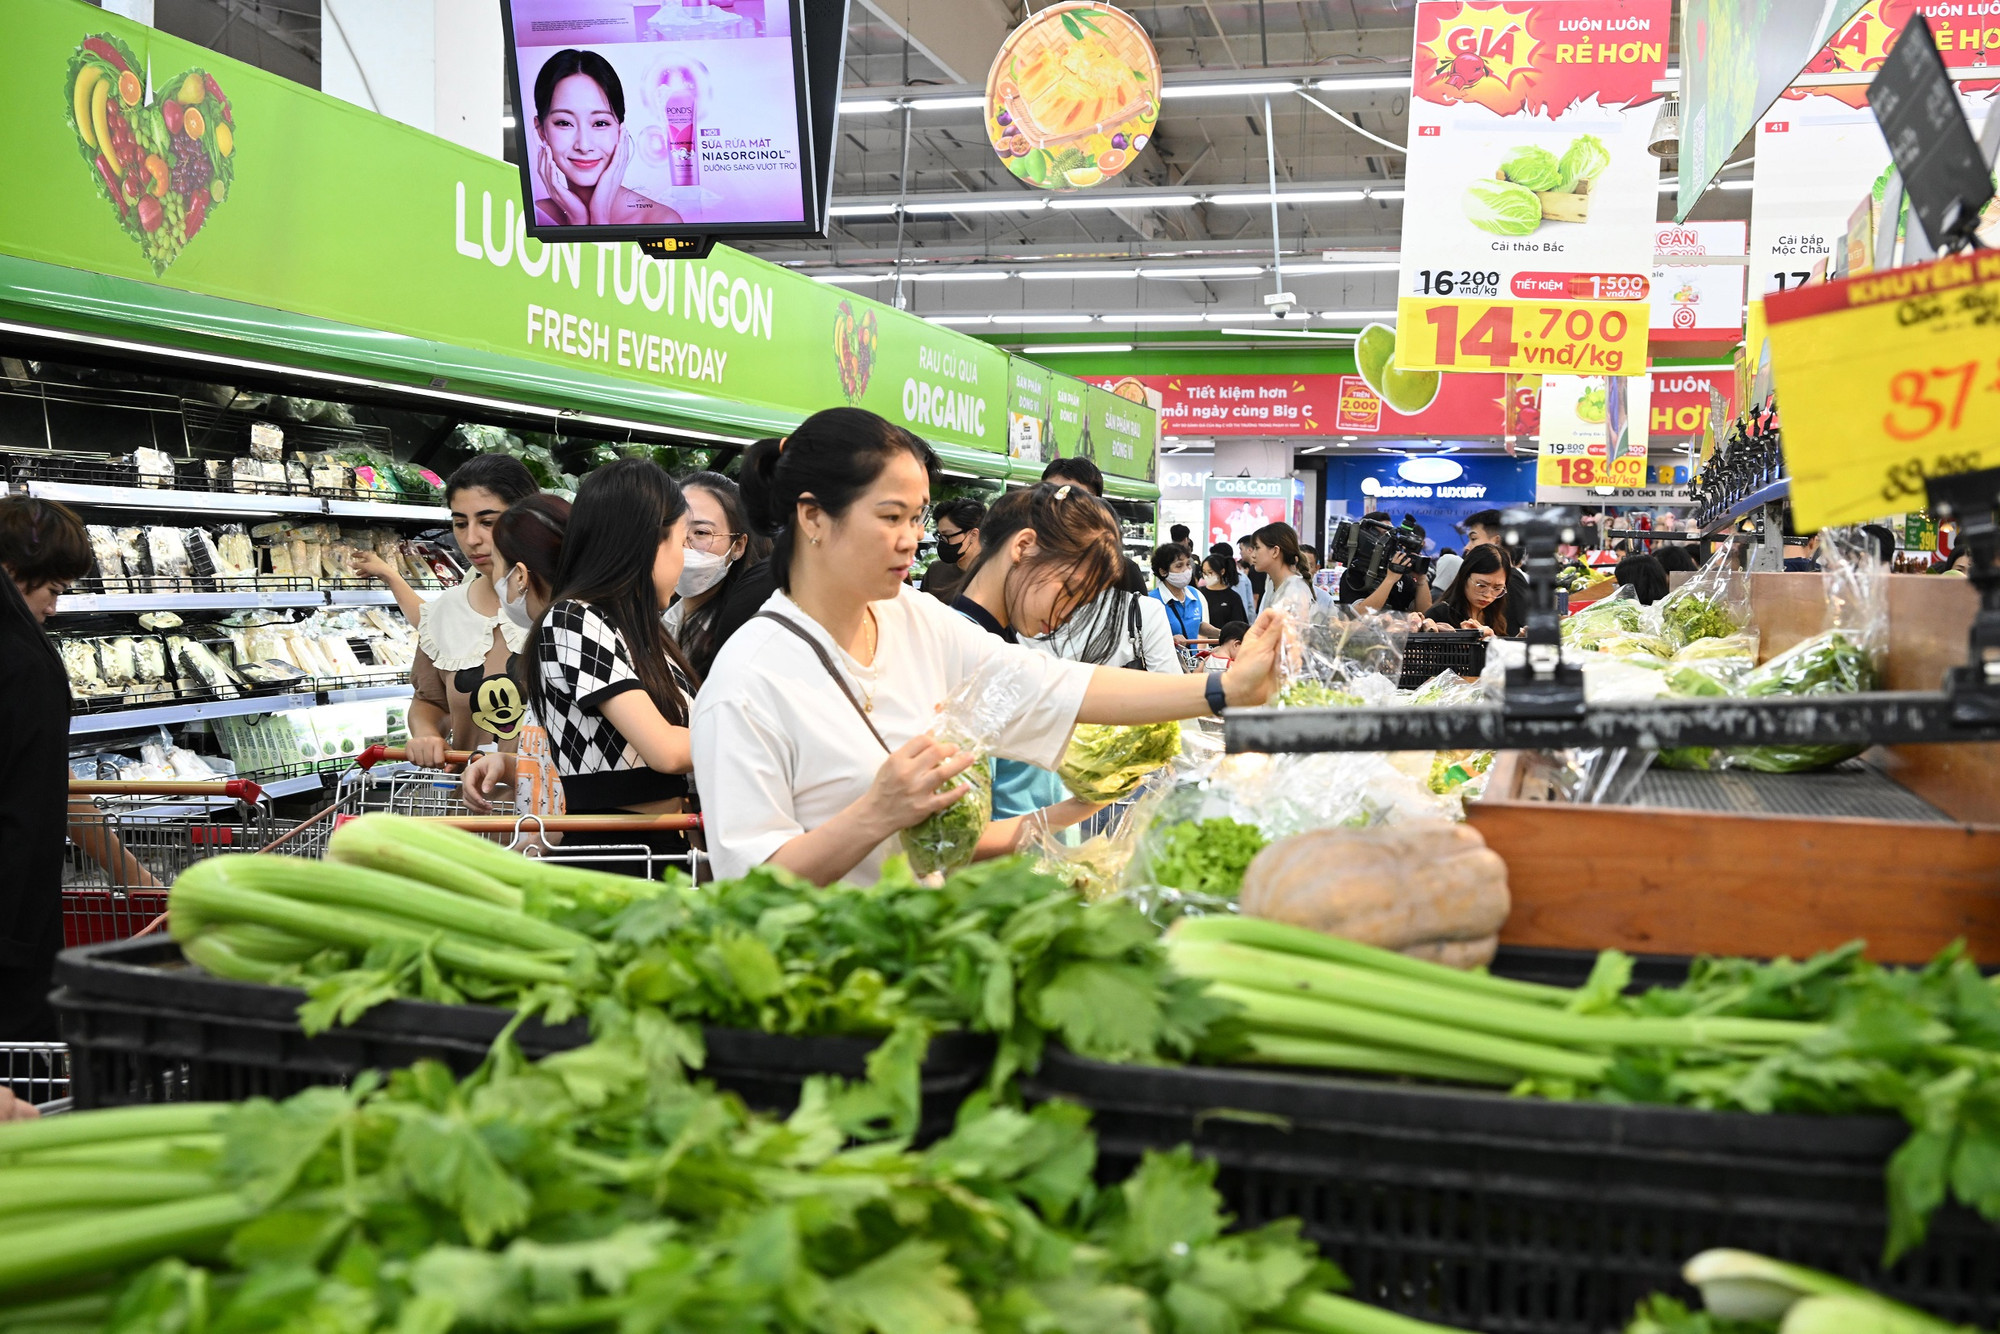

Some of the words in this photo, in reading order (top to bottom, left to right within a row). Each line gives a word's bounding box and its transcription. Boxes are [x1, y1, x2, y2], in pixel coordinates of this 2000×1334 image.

[1968, 0, 2000, 16] LUÔ
[1559, 17, 1602, 32] LUÔN
[1606, 16, 1650, 31] LUÔN
[1447, 24, 1522, 65] GIÁ
[1935, 22, 1954, 51] Ẻ
[1556, 36, 1593, 63] RẺ
[1598, 41, 1662, 63] HƠN
[666, 107, 692, 115] POND'S
[1424, 127, 1435, 135] 41
[1771, 123, 1784, 131] 41
[1658, 229, 1697, 246] CÂN
[1778, 236, 1797, 245] Cải
[1801, 235, 1824, 246] bắp
[1491, 241, 1510, 252] Cải
[1513, 242, 1540, 252] thảo
[1543, 242, 1564, 252] Bắc
[1772, 246, 1796, 256] Mộc
[1800, 245, 1830, 254] Châu
[1420, 270, 1500, 295] 16.200
[1515, 279, 1537, 290] TIẾT
[1538, 280, 1563, 292] KIỆM
[1590, 275, 1643, 299] 1.500
[1459, 286, 1498, 297] vnđ/kg
[1606, 289, 1642, 299] vnđ/kg
[684, 261, 773, 341] NGON
[527, 304, 609, 363] FRESH
[617, 329, 727, 384] EVERYDAY
[1426, 305, 1628, 367] 14.700
[919, 345, 940, 374] RAU
[943, 348, 956, 379] CỦ
[958, 358, 978, 385] QUẢ
[1523, 343, 1623, 372] vnđ/kg
[1660, 376, 1710, 393] LUÔN
[1186, 385, 1216, 399] Tiết
[1219, 386, 1255, 401] kiệm
[1259, 386, 1287, 399] hơn
[902, 377, 986, 437] ORGANIC
[1161, 402, 1189, 417] mỗi
[1192, 404, 1229, 419] ngày
[1232, 404, 1269, 419] cùng
[1273, 405, 1298, 419] Big
[1302, 405, 1313, 417] C
[1342, 400, 1377, 411] 2.000
[1550, 443, 1584, 454] 19.800
[1557, 458, 1641, 484] 18.000
[1216, 480, 1282, 493] Co&Com
[1595, 475, 1637, 487] vnđ/kg
[1436, 486, 1487, 498] LUXURY
[1637, 489, 1656, 497] CHƠI
[1920, 531, 1937, 550] 39k
